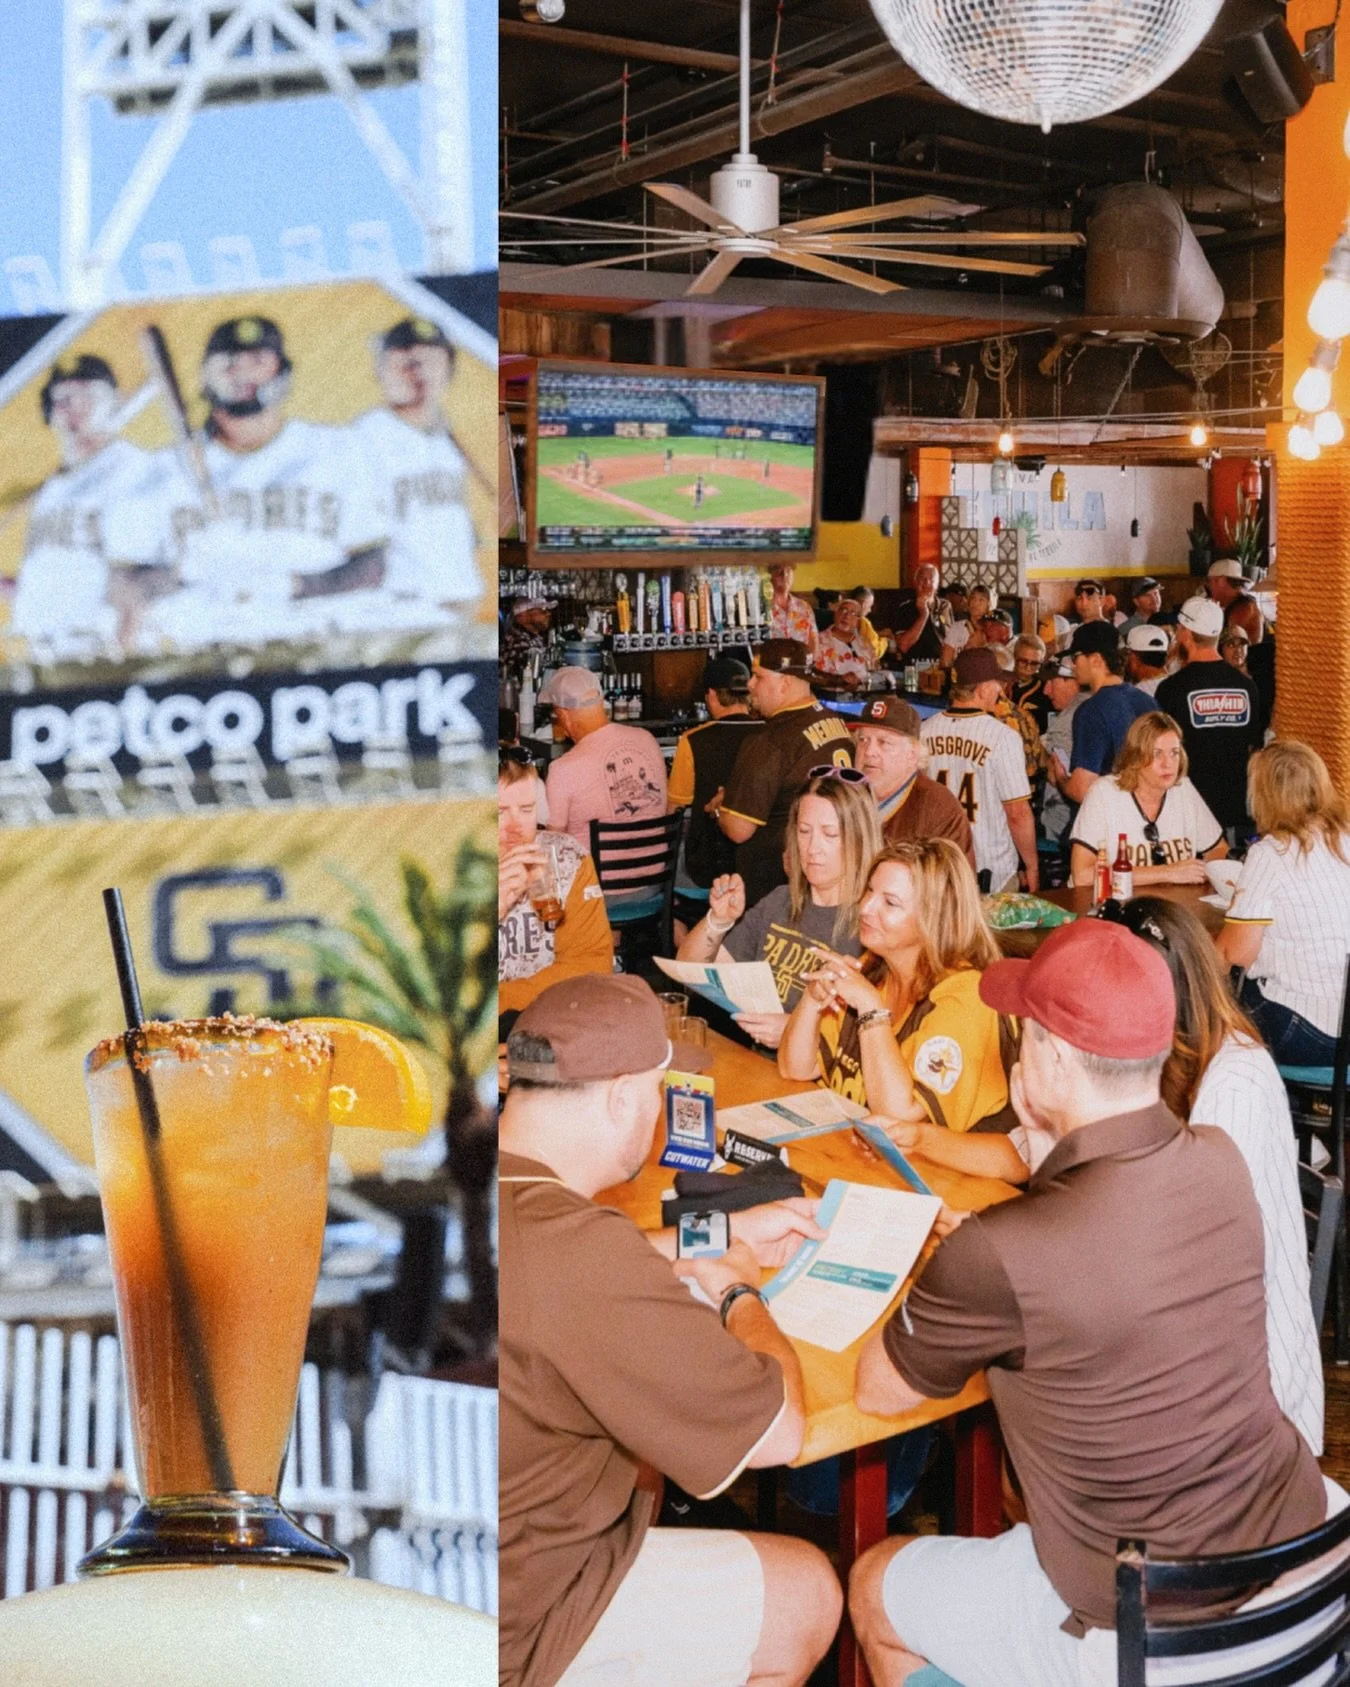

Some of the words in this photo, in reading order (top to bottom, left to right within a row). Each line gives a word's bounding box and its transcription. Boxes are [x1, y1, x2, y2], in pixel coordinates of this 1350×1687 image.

[11, 684, 263, 765] petco
[271, 667, 477, 761] park
[926, 735, 991, 767] USGROVE
